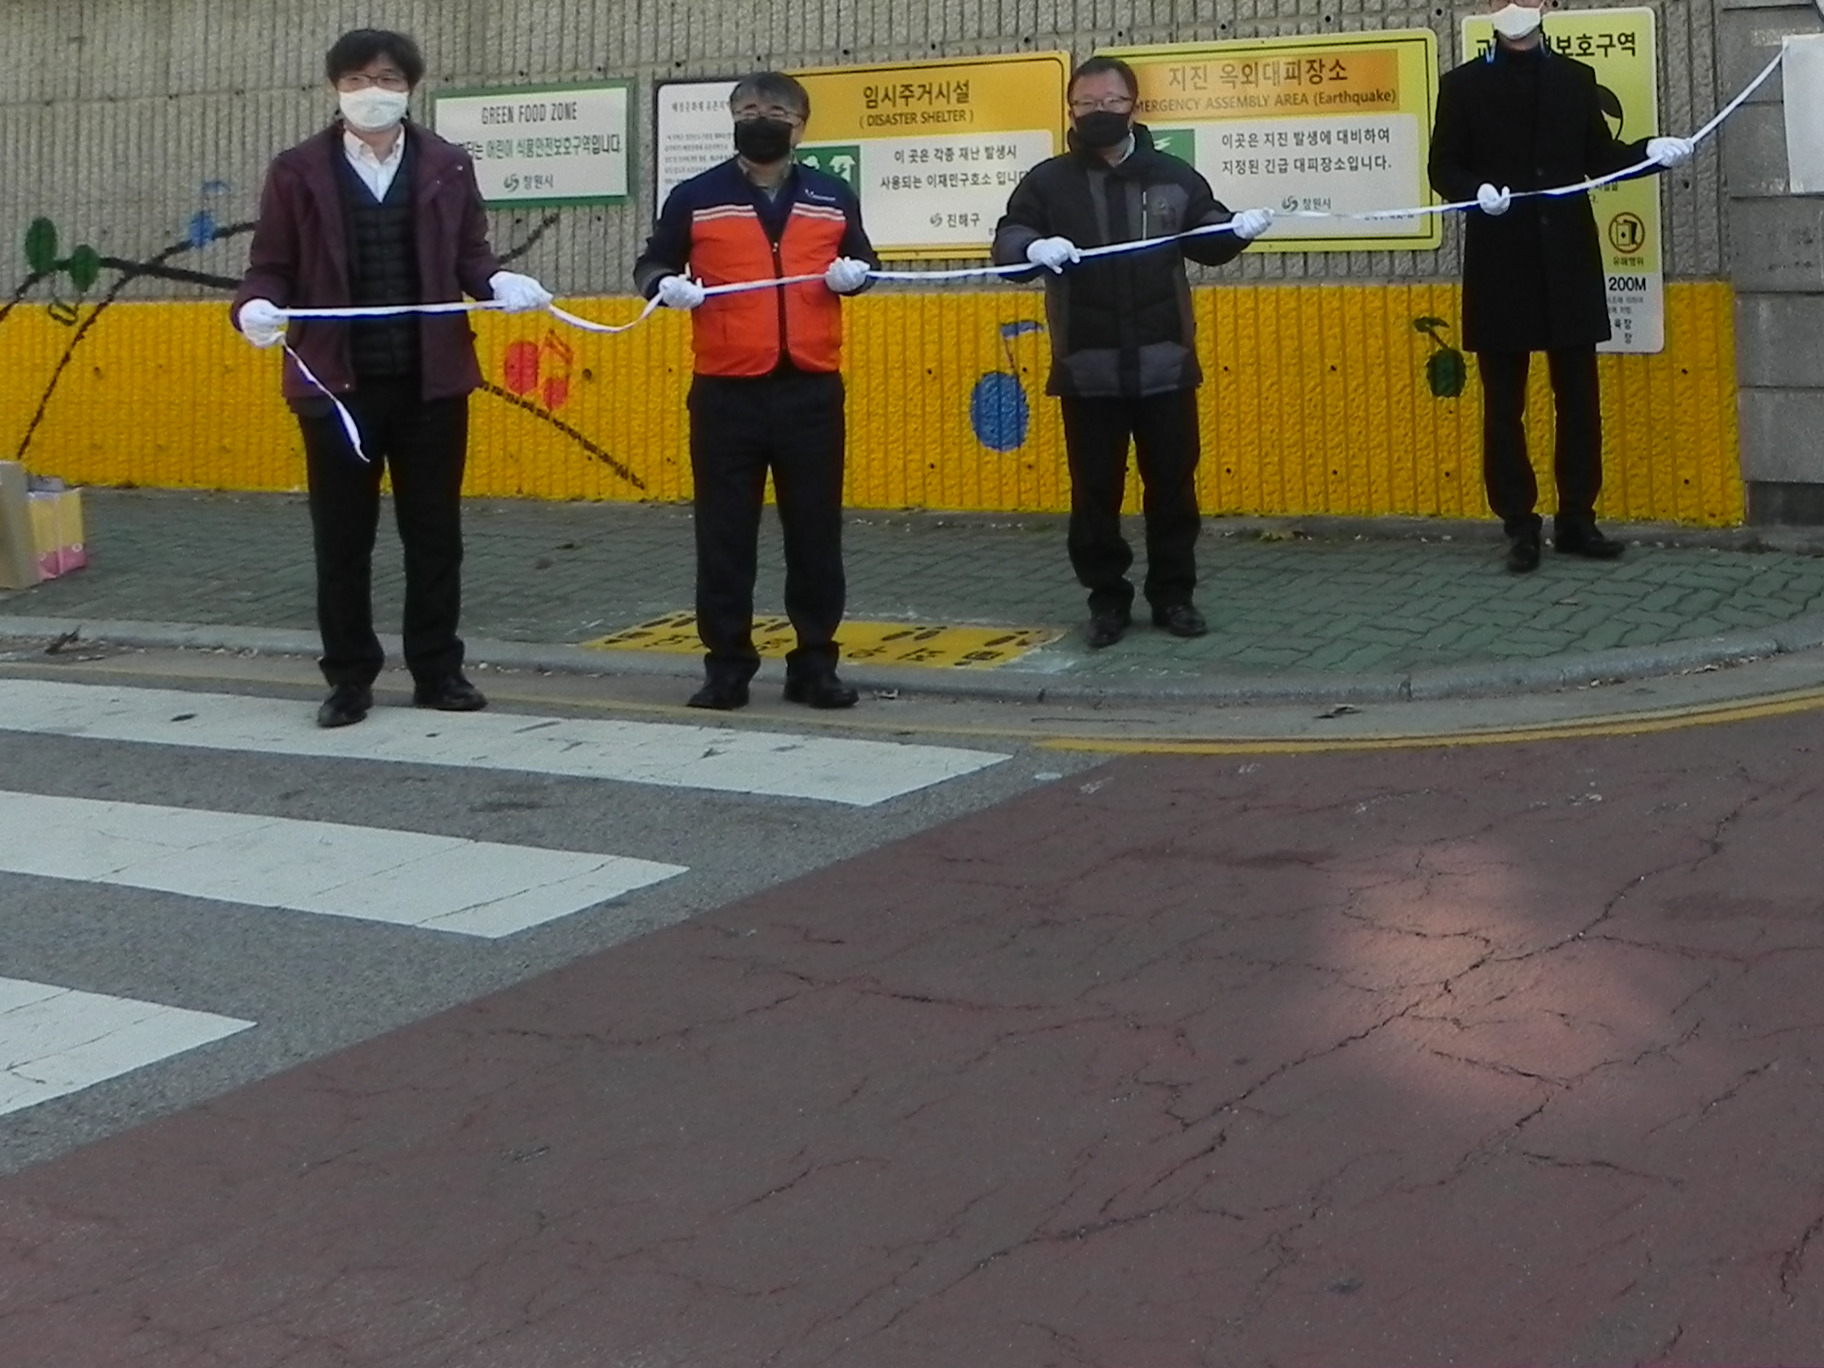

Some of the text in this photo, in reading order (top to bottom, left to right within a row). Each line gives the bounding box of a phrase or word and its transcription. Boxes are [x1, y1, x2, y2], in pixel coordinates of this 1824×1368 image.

[1168, 58, 1348, 91] 지진 옥외대피장소
[863, 79, 970, 109] 임시주거시설
[1136, 88, 1396, 114] MERGENCY ASSEMBLY AREA (Earthquake)
[481, 102, 577, 124] GREEN FOOD ZONE
[1222, 127, 1390, 150] 이곳은 지진 발생에 대비하여
[934, 147, 955, 162] 각종
[959, 146, 980, 161] 재난
[985, 145, 1017, 160] 발생시
[1222, 155, 1392, 176] 지정된 긴급 대피장소입니다.
[523, 174, 554, 191] 창원시
[880, 174, 922, 190] 사용되는
[1302, 196, 1332, 210] 창원시
[947, 213, 980, 228] 진해구
[1609, 277, 1646, 291] 200M
